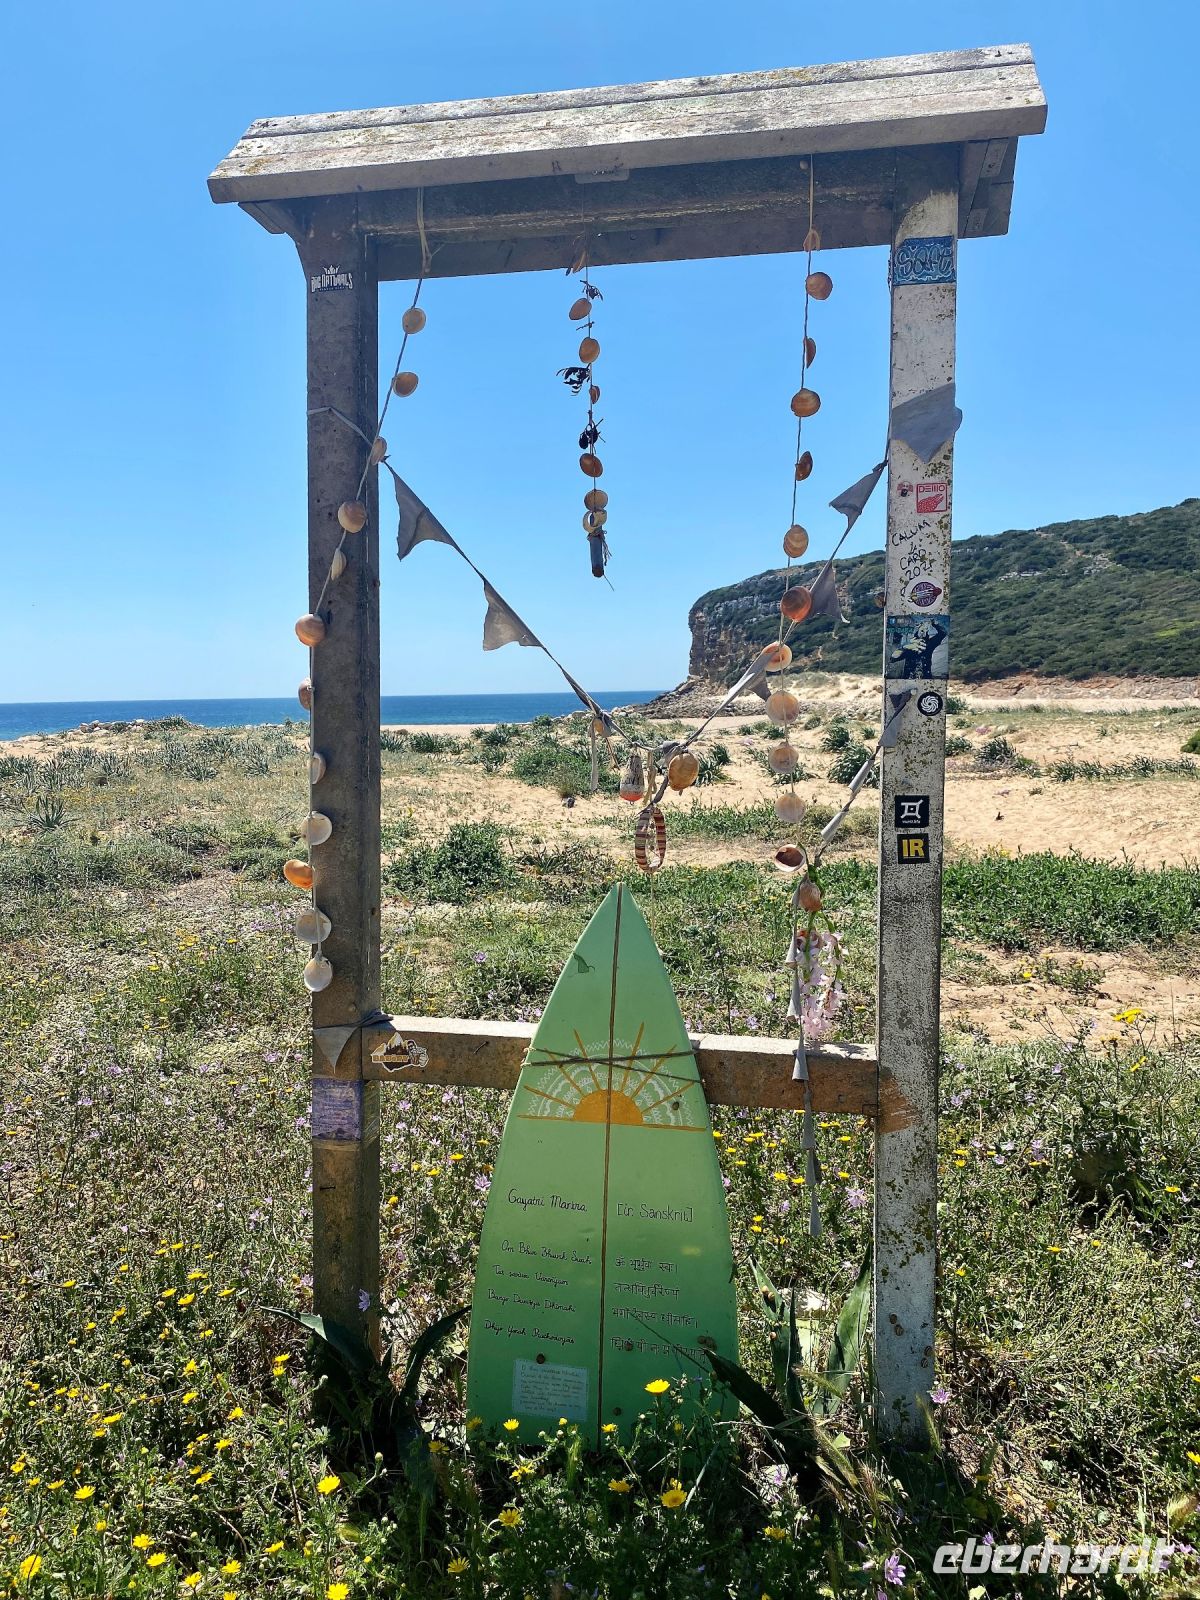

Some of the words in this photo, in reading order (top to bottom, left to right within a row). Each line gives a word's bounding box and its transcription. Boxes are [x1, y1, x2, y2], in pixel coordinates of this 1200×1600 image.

[918, 484, 946, 493] DEMO
[891, 519, 931, 547] CALUM
[902, 838, 925, 858] IR
[508, 1188, 545, 1211] Gayatri
[501, 1239, 514, 1253] Om
